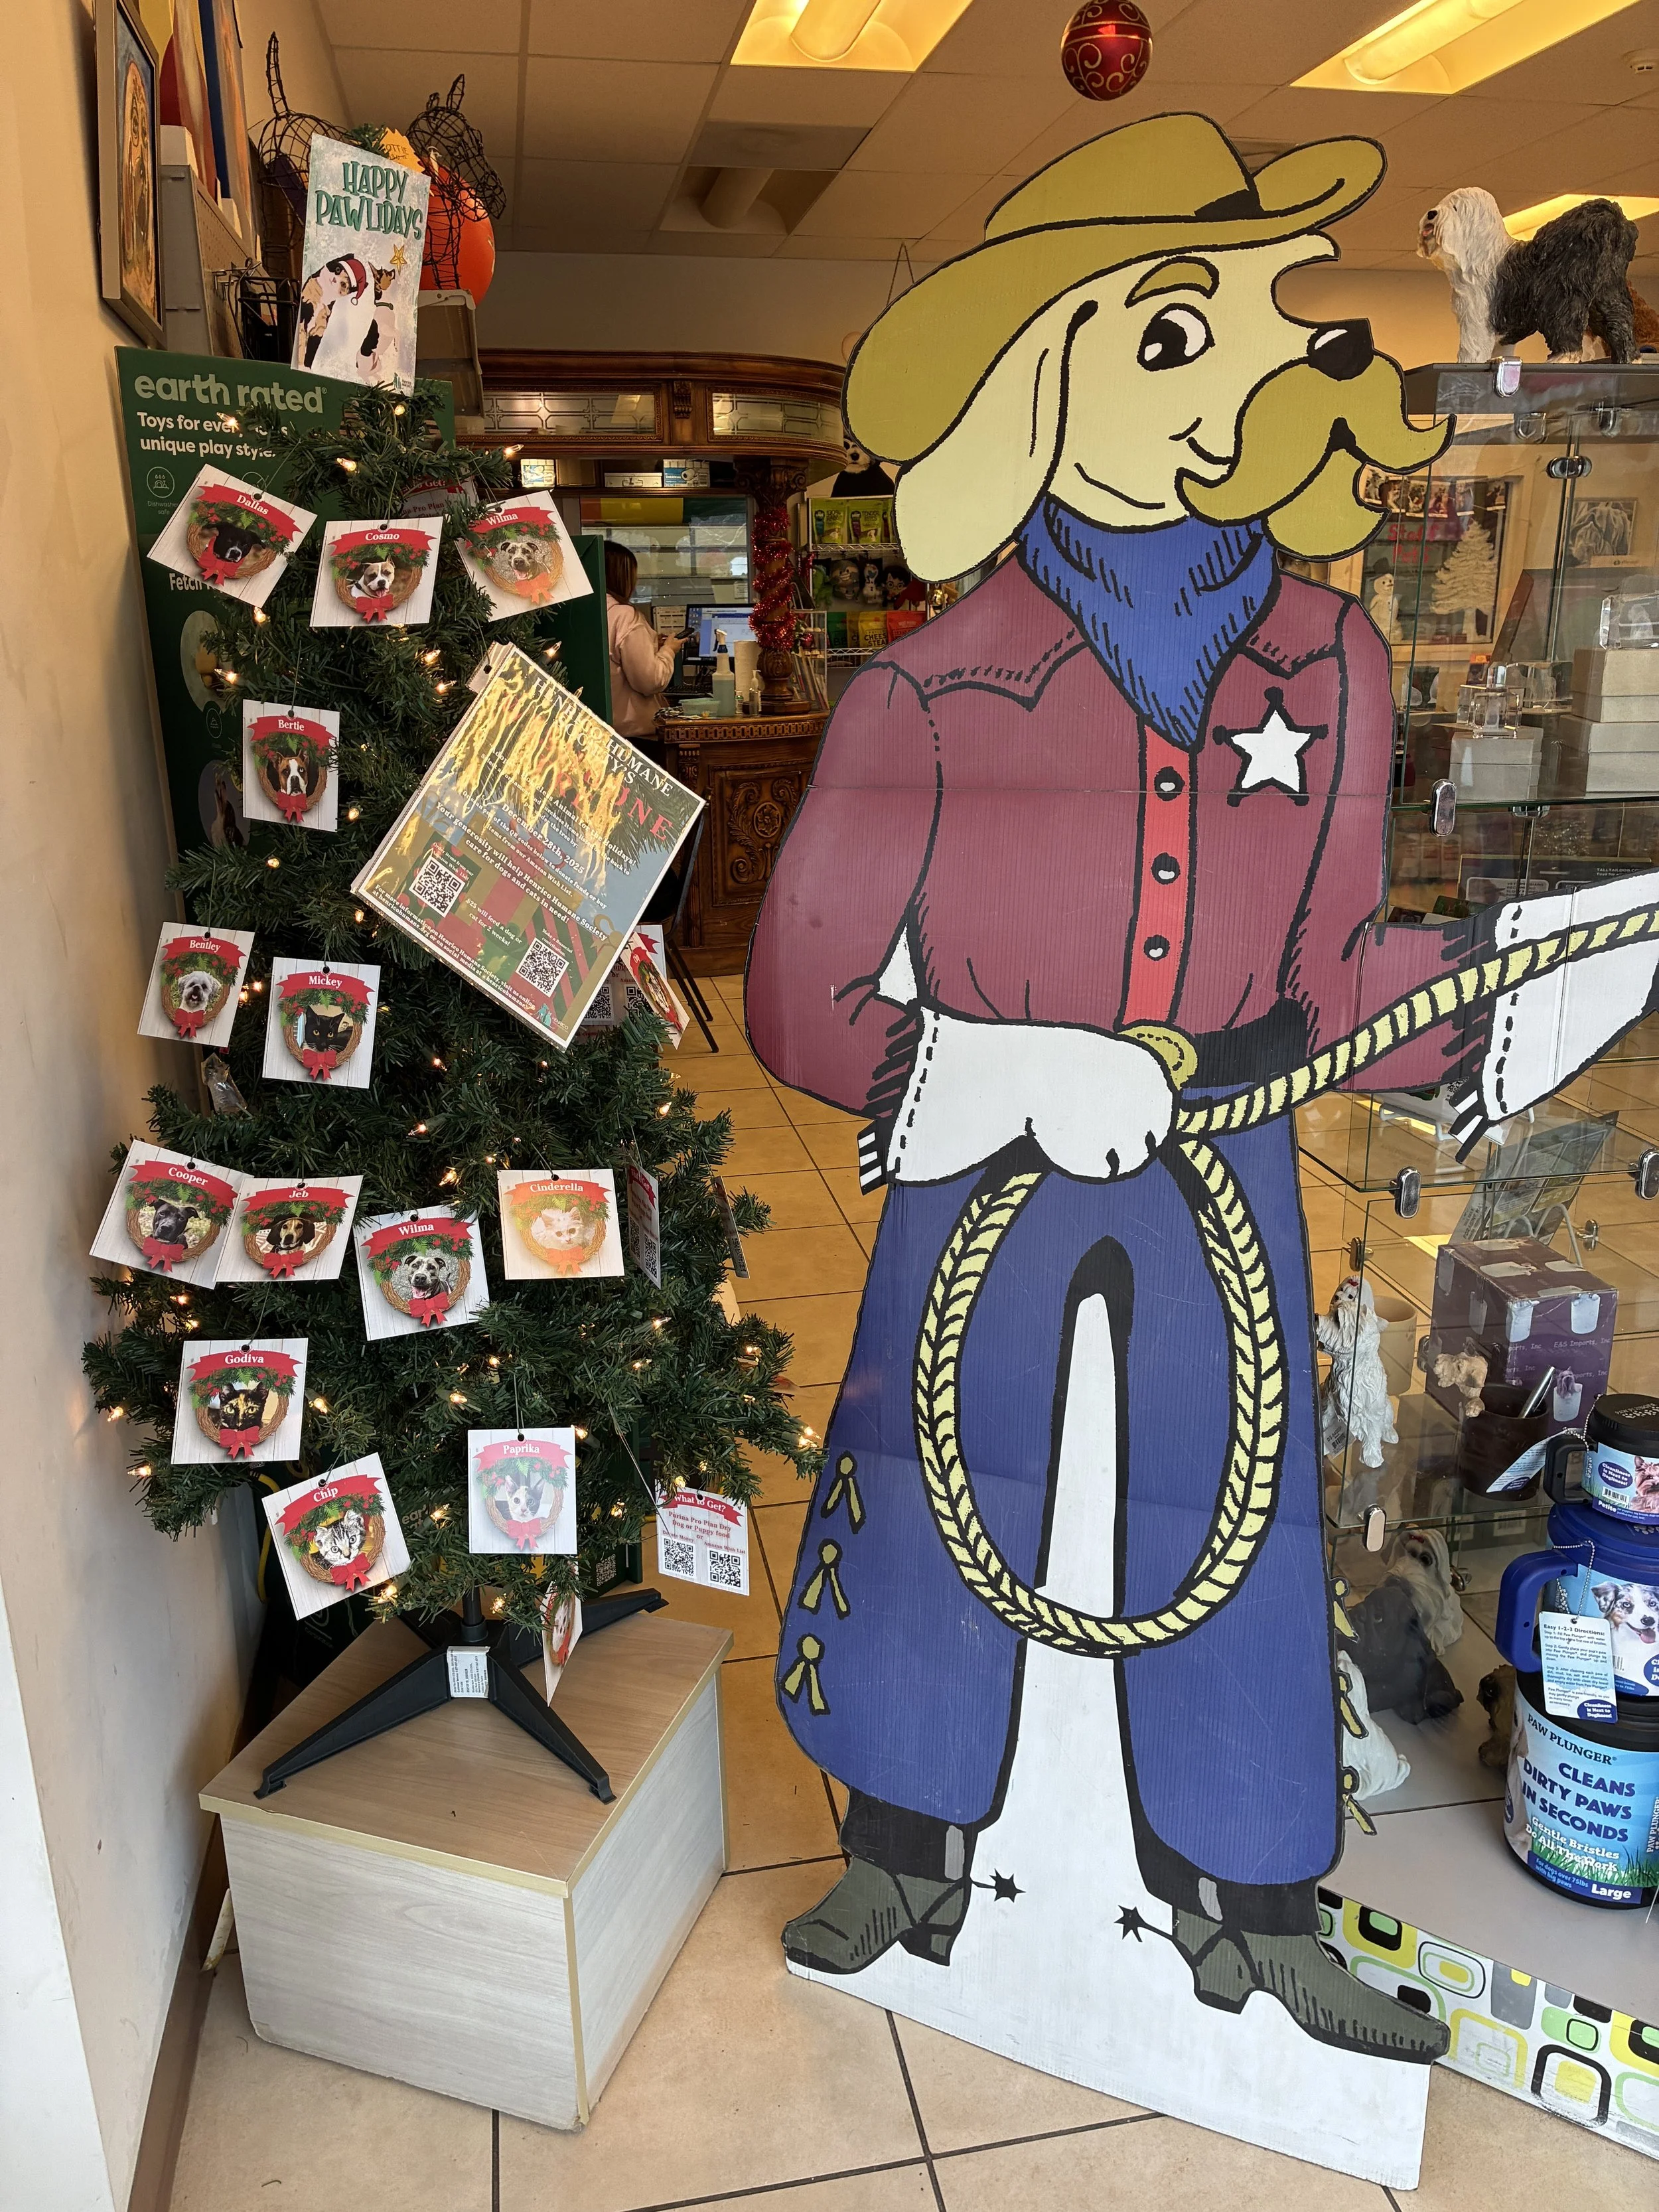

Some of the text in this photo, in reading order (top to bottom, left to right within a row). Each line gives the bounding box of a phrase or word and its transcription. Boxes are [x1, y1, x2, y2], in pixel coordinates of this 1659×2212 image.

[342, 161, 409, 203] HAPPY
[315, 190, 423, 240] PAWLIDAYS
[135, 374, 230, 406] earth
[137, 411, 200, 432] Toys for
[140, 436, 232, 459] unique play
[236, 494, 269, 515] Dallas
[486, 512, 519, 526] Wilma
[365, 532, 399, 541] Cosmo
[169, 573, 202, 591] Fetch
[278, 719, 305, 731] Bertie
[605, 737, 674, 798] HUMANE
[500, 802, 585, 875] December 28th, 2025
[552, 798, 636, 867] Animal Holidays!
[558, 830, 573, 844] tree
[431, 841, 467, 871] Order from
[563, 822, 630, 876] items back to
[447, 862, 459, 873] Wish
[485, 824, 575, 897] items from our Amazon Wish List.
[492, 815, 607, 911] of the QR codes below to donate funds or buy
[435, 801, 608, 943] Your generosity will help Henrico Humane Society
[464, 838, 570, 924] care for dogs and cats in need!
[371, 889, 380, 898] at
[429, 934, 437, 942] or
[443, 944, 459, 959] social
[459, 957, 476, 972] media
[465, 897, 478, 909] $25
[476, 906, 488, 918] will
[486, 914, 500, 928] feed
[503, 927, 516, 940] dog
[514, 936, 522, 945] or
[468, 912, 480, 922] cat
[477, 919, 488, 929] for
[490, 928, 511, 947] weeks!
[374, 883, 519, 998] For more information Henrico Humane Society, visit us
[541, 928, 553, 939] Make
[189, 940, 221, 954] Bentley
[309, 976, 342, 989] Mickey
[168, 1167, 208, 1187] Cooper
[289, 1190, 309, 1199] Jeb
[530, 1183, 584, 1193] Cinderella
[398, 1223, 435, 1236] Wilma
[1569, 1339, 1597, 1348] Imports,
[224, 1354, 264, 1365] Godiva
[502, 1445, 540, 1456] Paprika
[1602, 1462, 1631, 1477] Cleanliness
[1602, 1472, 1628, 1486] Dogliness!
[1608, 1470, 1620, 1480] Next
[313, 1487, 339, 1503] Chip
[674, 1495, 695, 1504] What
[707, 1500, 727, 1512] Get?
[1598, 1499, 1617, 1513] Petite
[668, 1511, 732, 1532] Purina Pro Plan Dry
[672, 1519, 684, 1529] Dog
[694, 1525, 714, 1536] Puppy
[715, 1530, 730, 1538] food
[679, 1534, 694, 1543] Money
[703, 1541, 723, 1550] Amazon
[1574, 1627, 1605, 1637] Directions:
[1528, 1713, 1548, 1737] PAW
[1523, 1757, 1632, 1820] DIRTY PAWS
[1558, 1762, 1636, 1797] CLEANS
[1522, 1781, 1536, 1805] IN
[1539, 1798, 1628, 1842] SECONDS
[1526, 1822, 1619, 1872] Do All Work
[1532, 1816, 1620, 1860] Gentle Bristles
[1646, 1834, 1656, 1853] PAW
[1535, 1865, 1572, 1889] with big paws
[1545, 1862, 1589, 1888] dogs over 75lbs
[1591, 1883, 1632, 1901] Large
